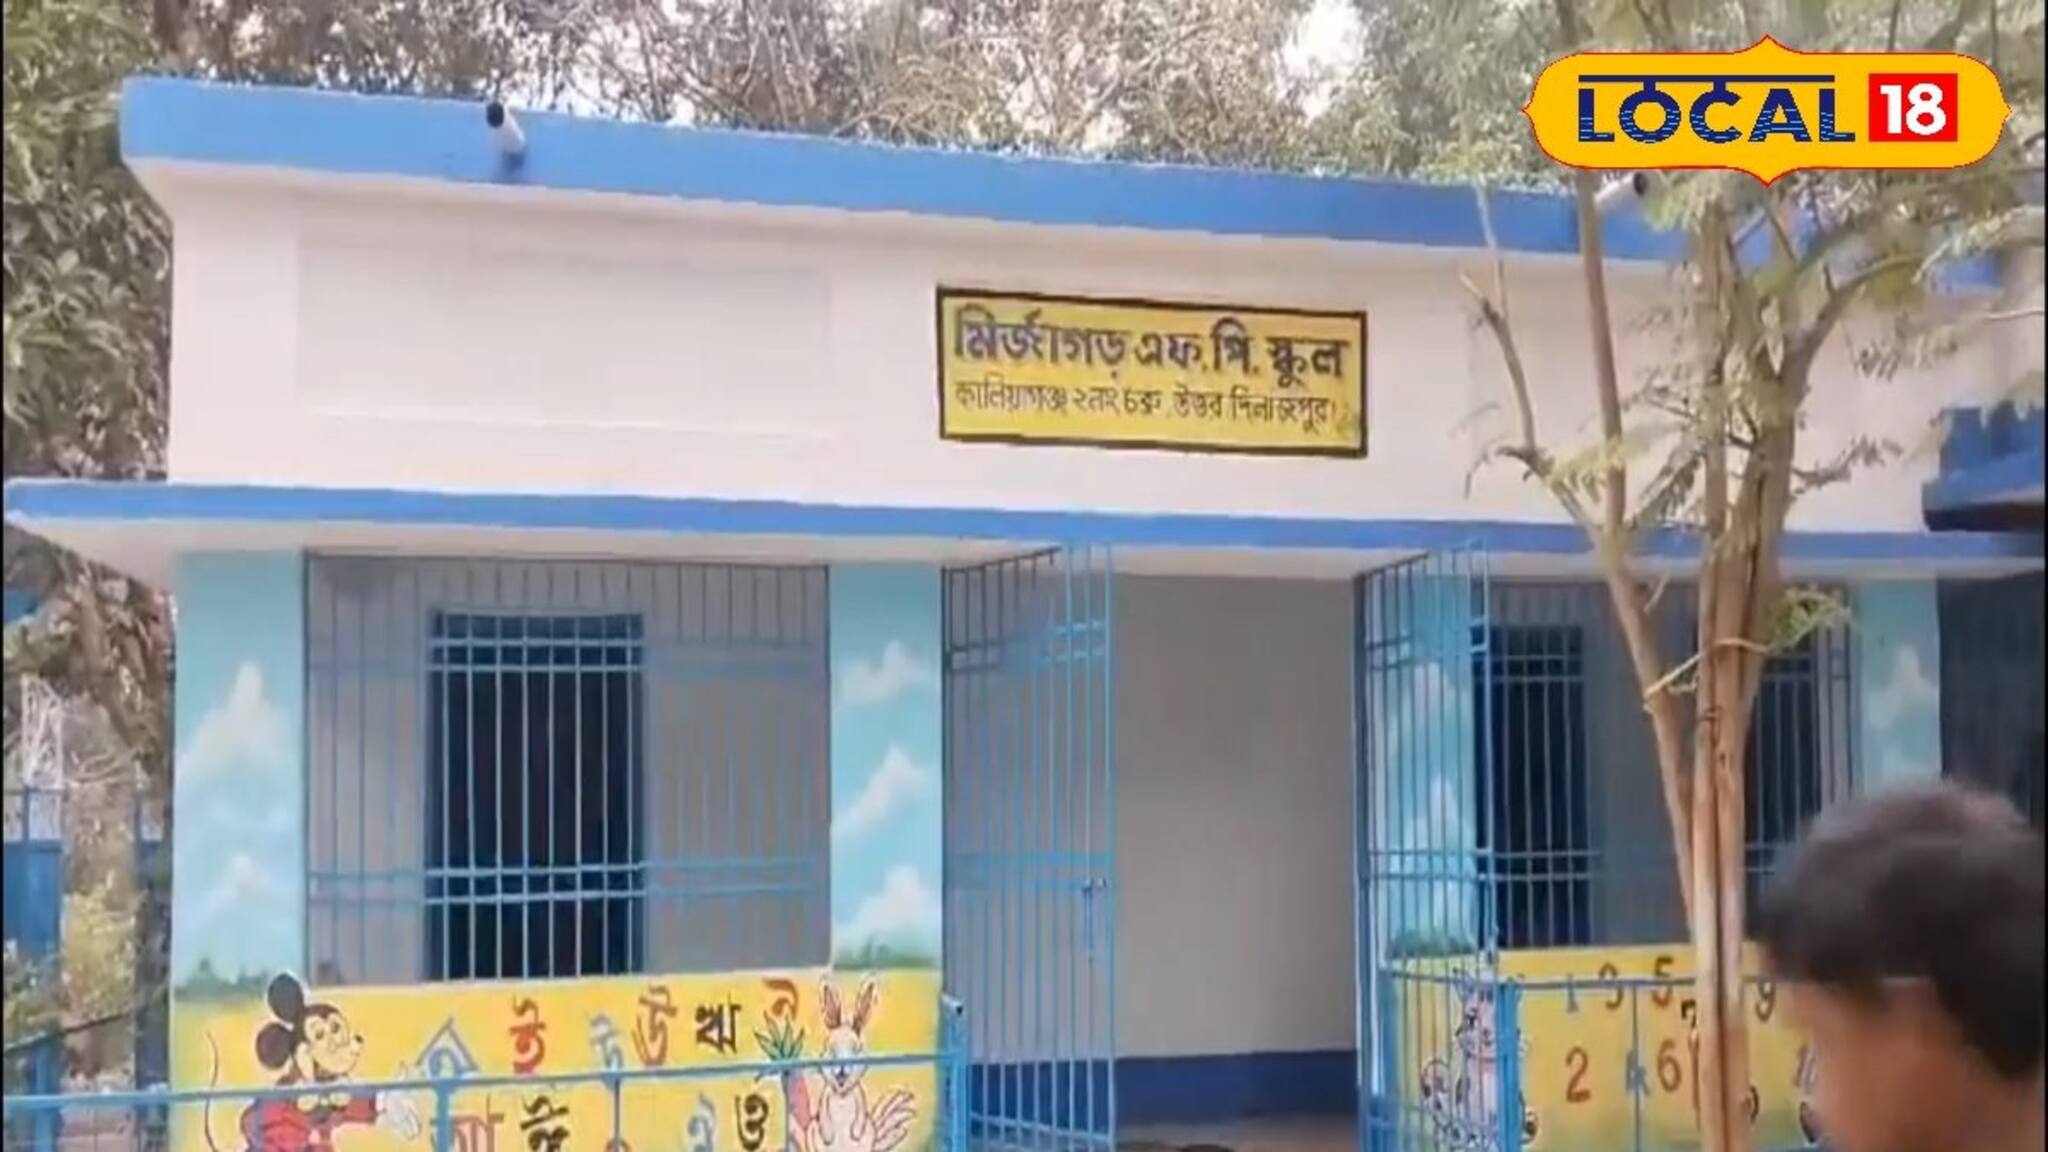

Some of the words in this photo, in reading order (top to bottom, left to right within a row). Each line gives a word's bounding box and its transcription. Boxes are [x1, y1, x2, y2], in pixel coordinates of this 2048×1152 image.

[955, 303, 1132, 380] মির্জাগড়
[1264, 335, 1350, 389] স্কুল
[1565, 1046, 1591, 1103] 2
[1656, 1039, 1682, 1093] 6
